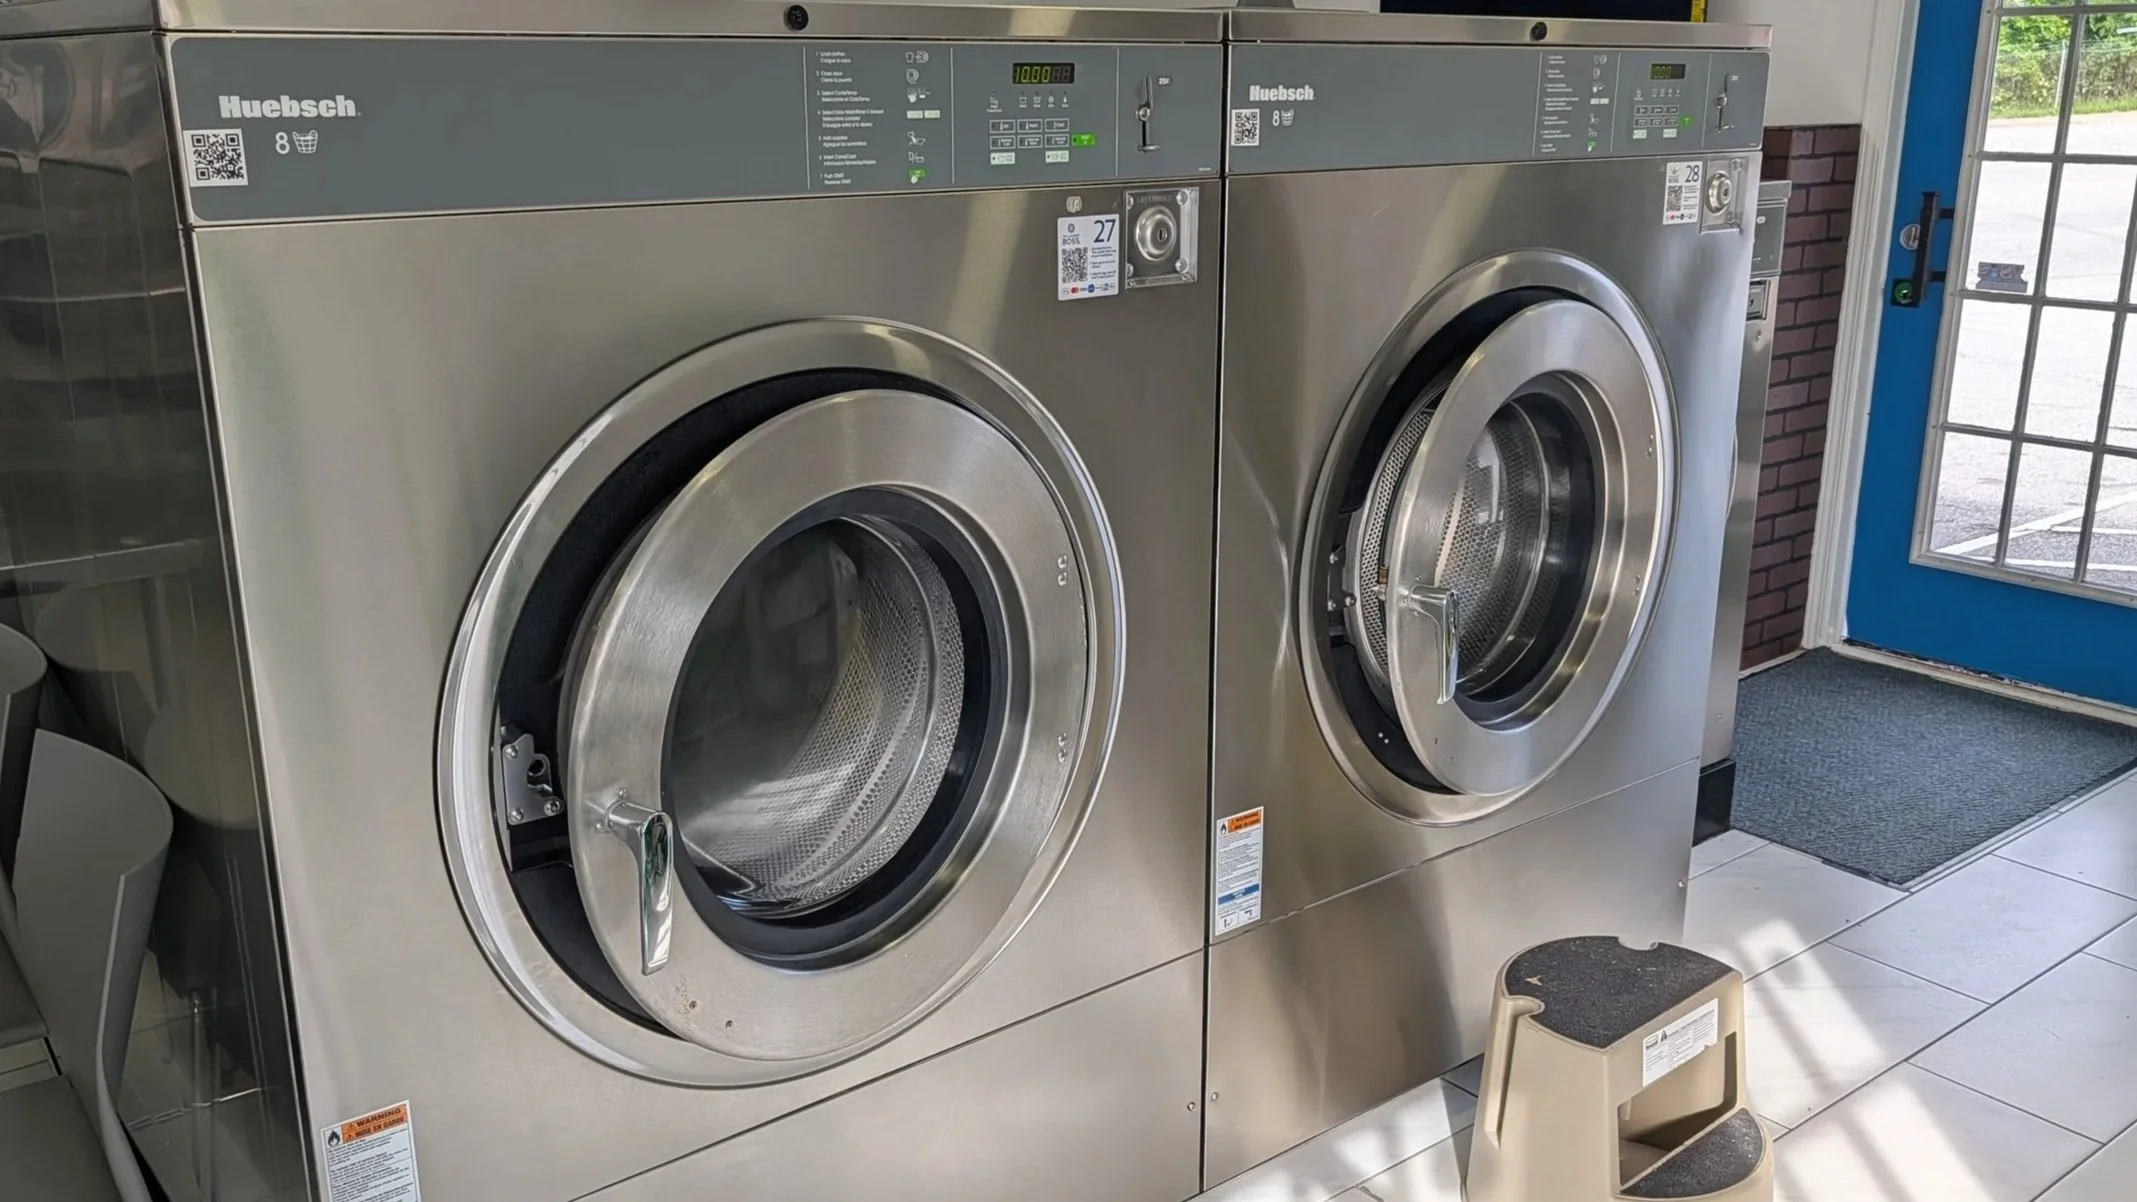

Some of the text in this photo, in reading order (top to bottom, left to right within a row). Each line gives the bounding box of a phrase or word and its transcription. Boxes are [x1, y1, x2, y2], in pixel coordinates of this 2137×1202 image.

[1249, 84, 1315, 102] Huebsch
[218, 95, 357, 119] Huebsch
[1272, 109, 1280, 126] 8
[275, 131, 291, 154] 8
[1684, 164, 1700, 183] 28
[1093, 218, 1117, 244] 27
[356, 1107, 402, 1127] WARNING
